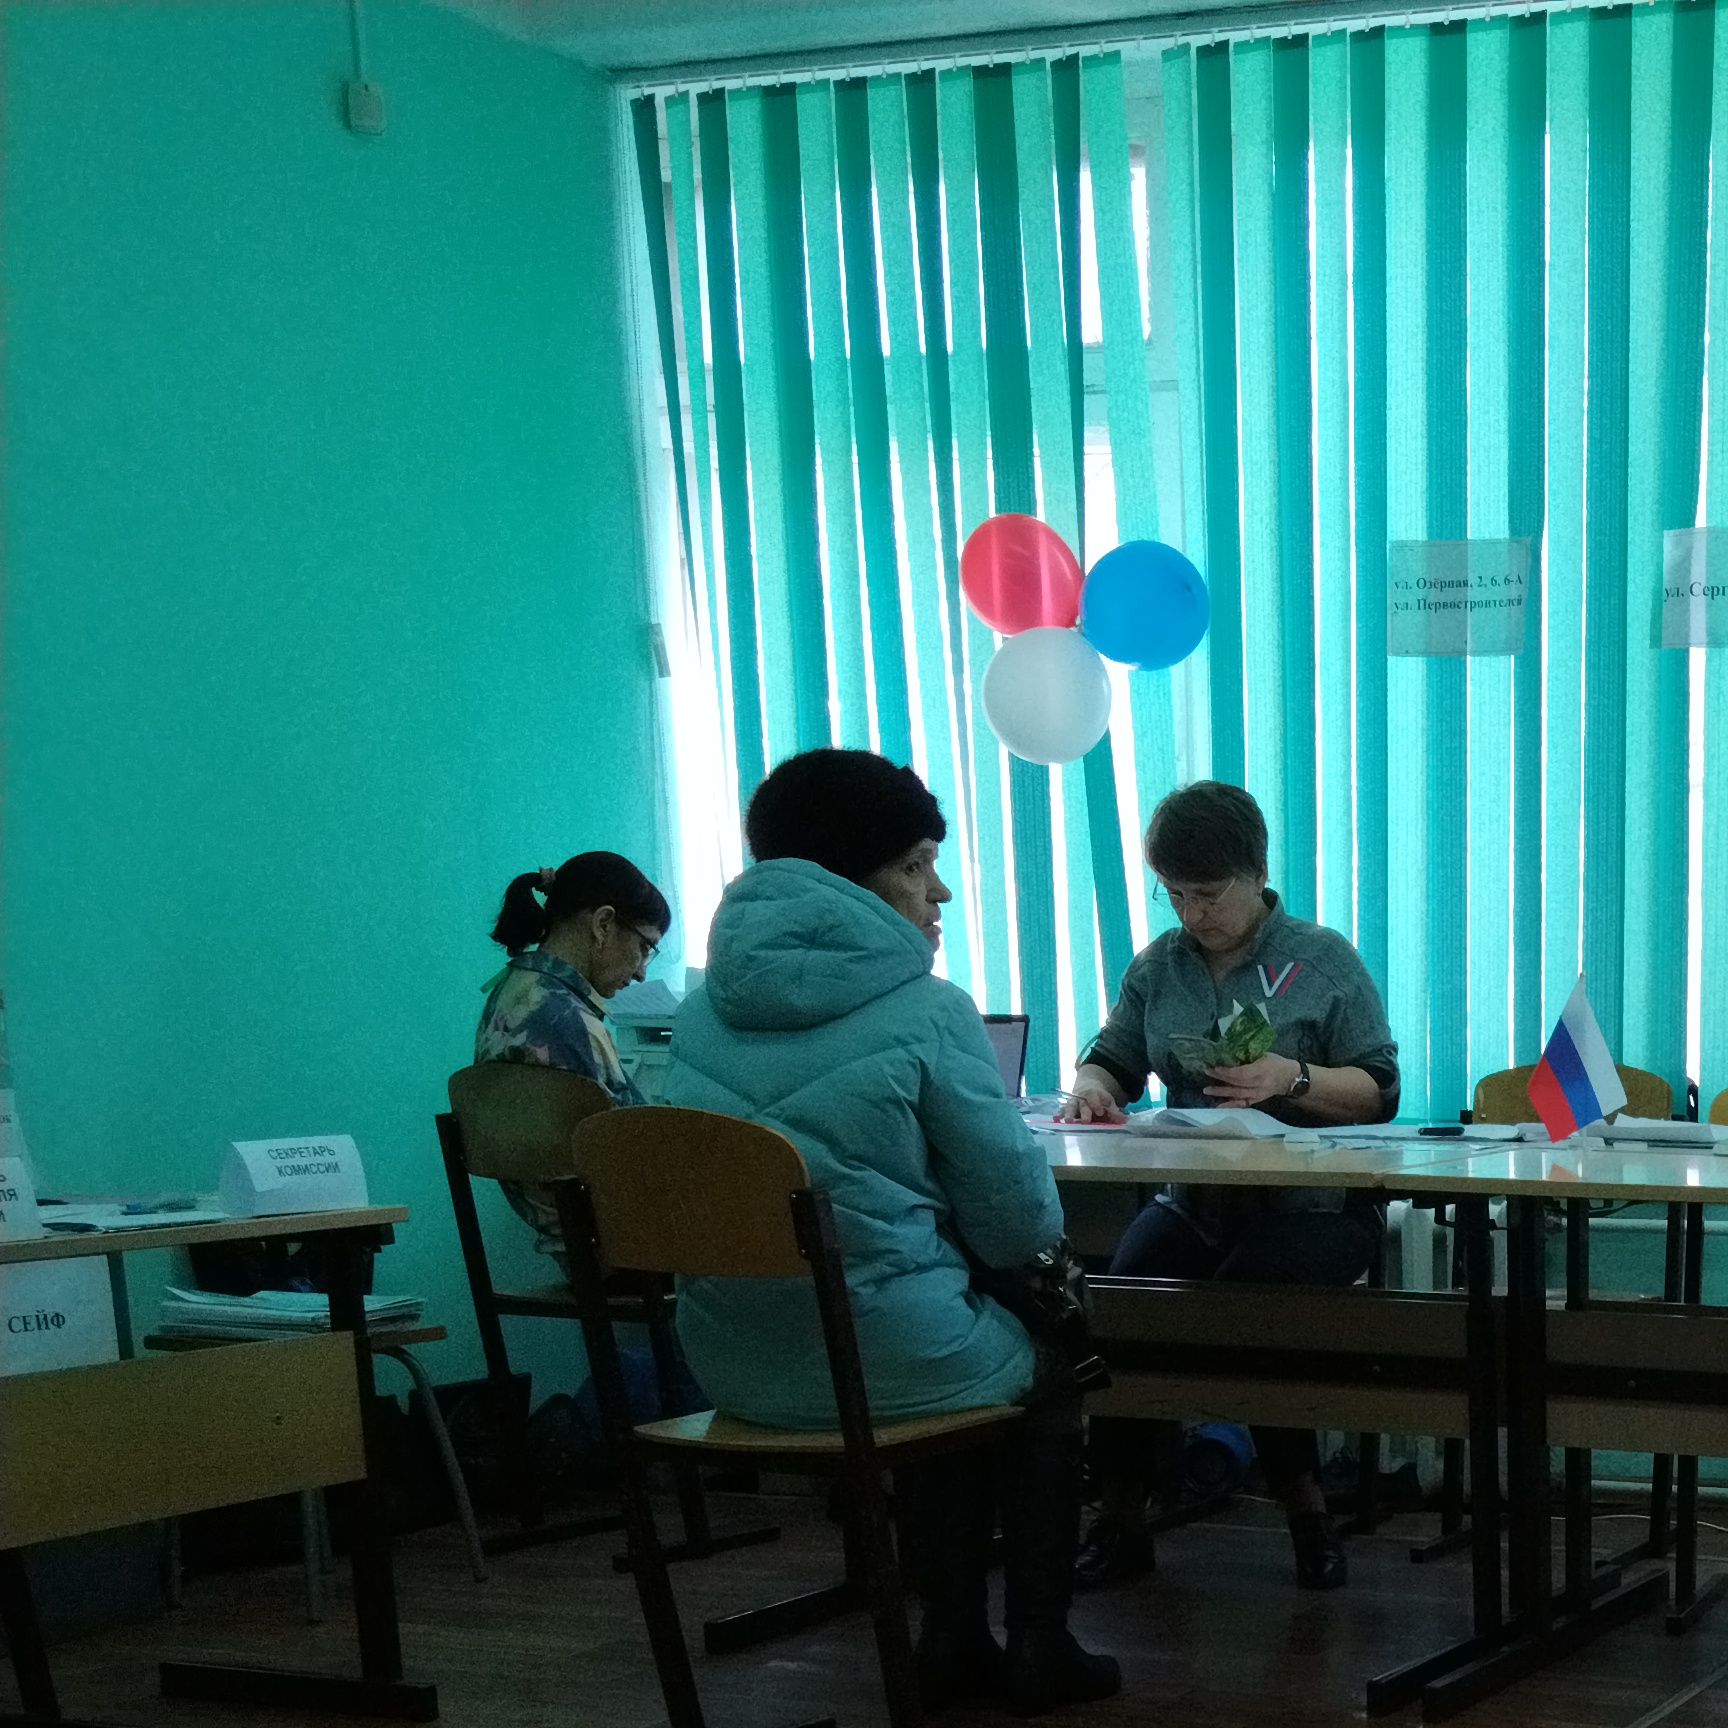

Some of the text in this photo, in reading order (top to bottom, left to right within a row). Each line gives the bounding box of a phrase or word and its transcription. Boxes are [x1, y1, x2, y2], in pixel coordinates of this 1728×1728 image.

[1663, 586, 1685, 602] ул.
[267, 1145, 336, 1160] СЕКРЕТАРЬ
[275, 1161, 342, 1177] КОМИССИИ
[8, 1308, 66, 1334] СЕЙФ
